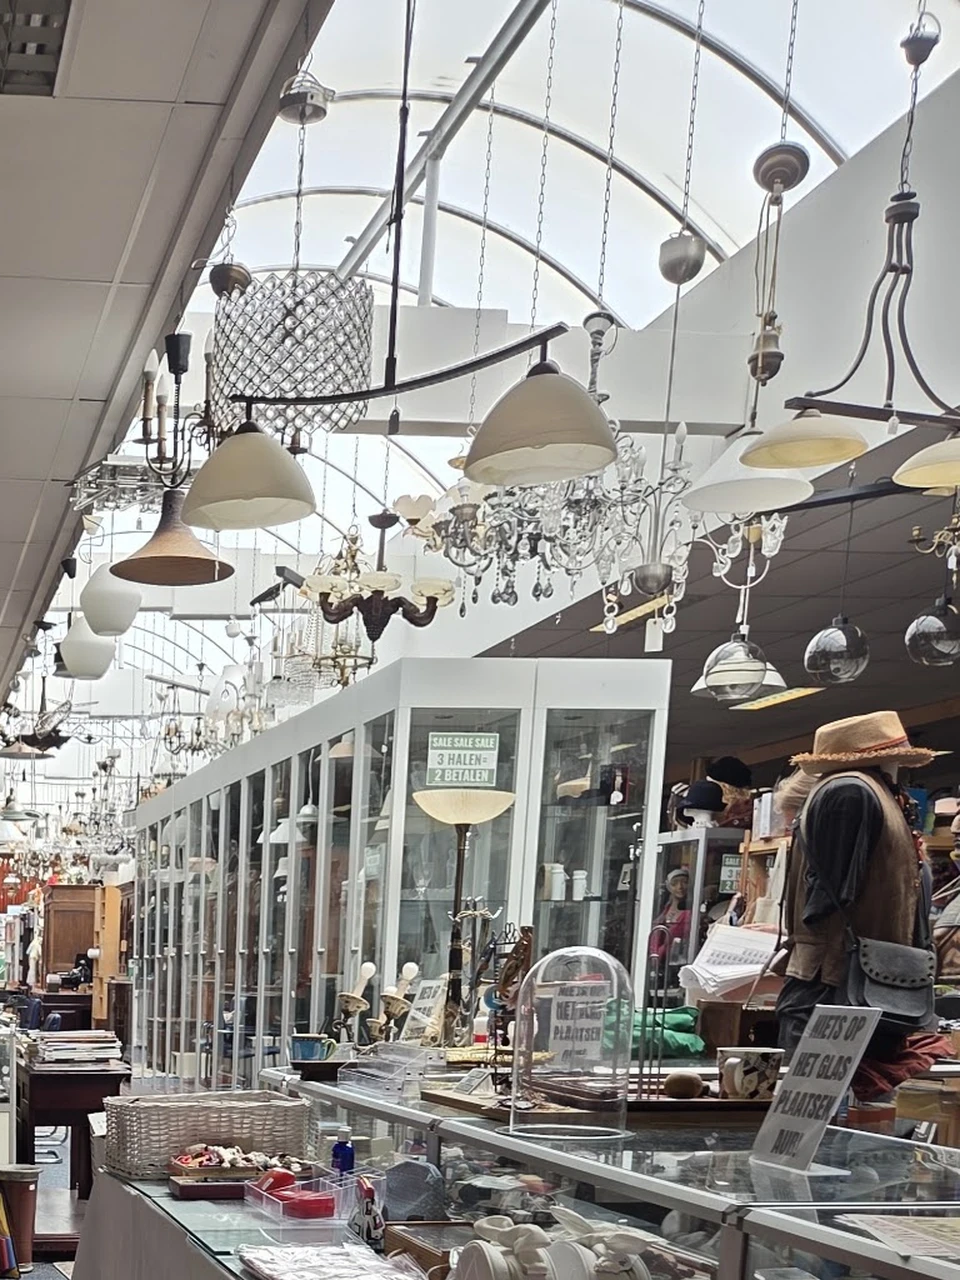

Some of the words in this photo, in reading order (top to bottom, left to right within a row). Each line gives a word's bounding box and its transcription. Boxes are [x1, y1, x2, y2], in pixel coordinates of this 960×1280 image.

[432, 737, 452, 747] SALE
[453, 737, 473, 748] SALE
[474, 738, 495, 748] SALE
[437, 754, 444, 765] 3
[434, 769, 442, 781] 2
[444, 769, 489, 782] BETALEN
[725, 881, 731, 890] 2
[808, 1014, 847, 1041] NIETS
[844, 1016, 867, 1041] OP
[792, 1052, 821, 1078] HET
[815, 1055, 853, 1081] GLAS
[774, 1090, 837, 1121] PLAATSEN
